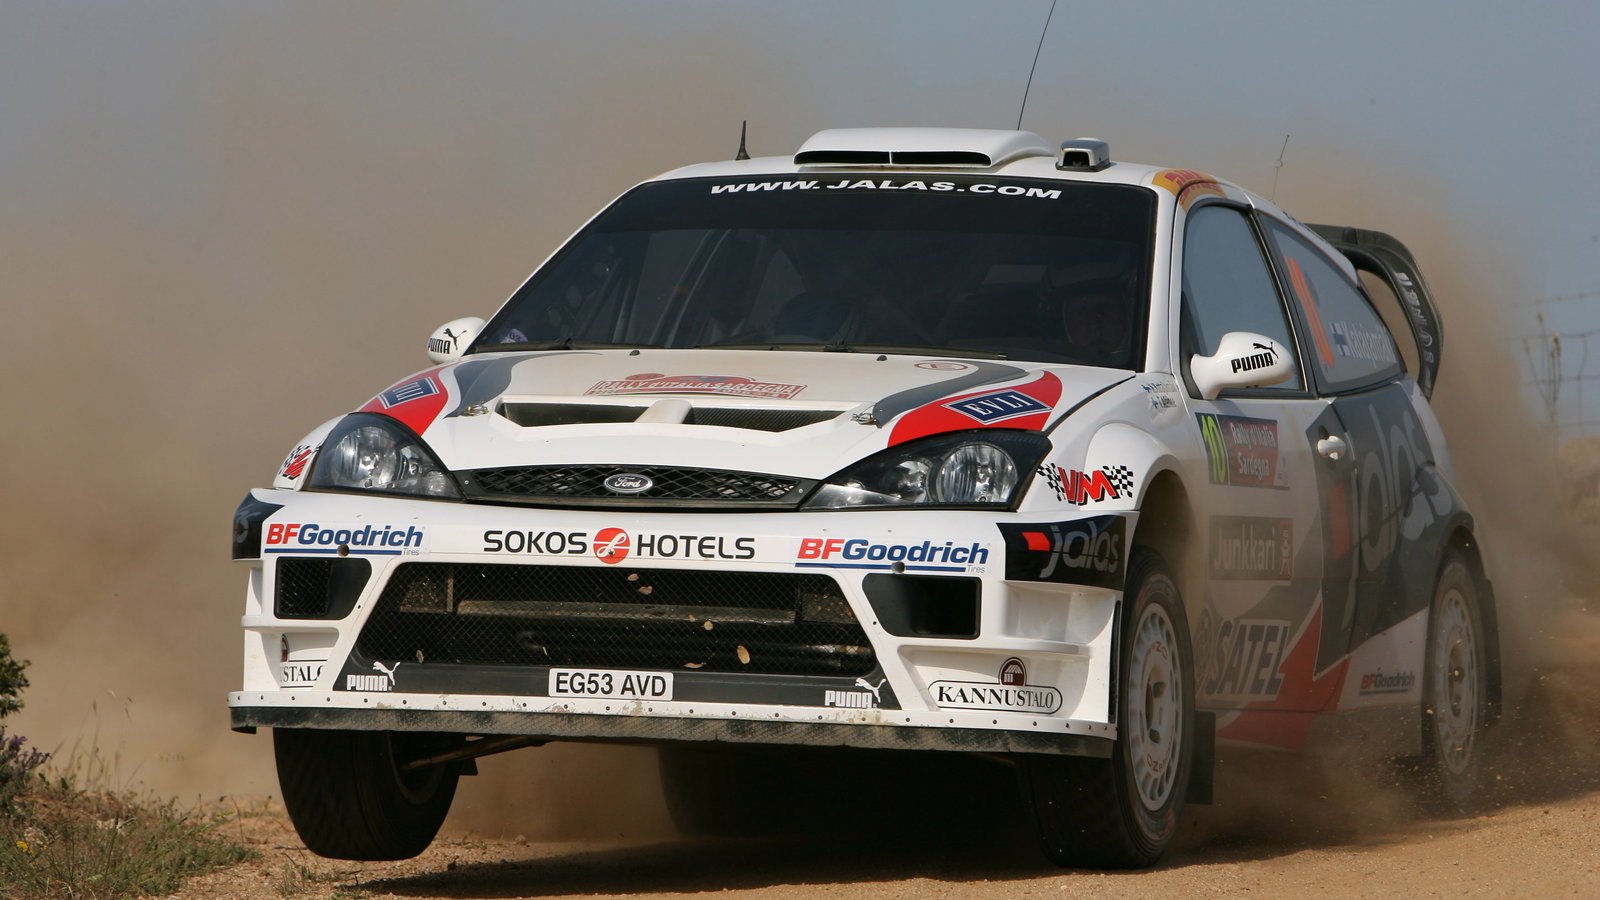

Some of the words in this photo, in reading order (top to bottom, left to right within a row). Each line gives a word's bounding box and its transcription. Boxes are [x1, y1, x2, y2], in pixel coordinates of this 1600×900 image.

[428, 338, 451, 354] UMA
[1231, 352, 1274, 374] PUMA
[963, 394, 1033, 416] EVLI
[1201, 415, 1226, 483] 10
[1238, 452, 1270, 481] Sardegna
[614, 476, 642, 488] Ford
[1058, 467, 1121, 506] VM
[266, 523, 424, 548] BFGoodrich
[483, 530, 588, 555] SOKOS
[637, 533, 756, 560] HOTELS
[1213, 522, 1276, 571] Junkkari
[401, 548, 420, 557] Tires
[797, 537, 989, 565] BFGoodrich
[1039, 521, 1119, 578] jalas
[966, 564, 986, 574] Tires
[1205, 620, 1289, 697] SATEL
[280, 664, 325, 683] STAL
[346, 674, 388, 691] PUMA
[556, 672, 614, 695] EG53
[620, 674, 667, 697] AVD
[1360, 671, 1416, 690] BFGoodrich
[824, 690, 873, 709] PUMA
[937, 685, 1055, 709] KANNUSTALO
